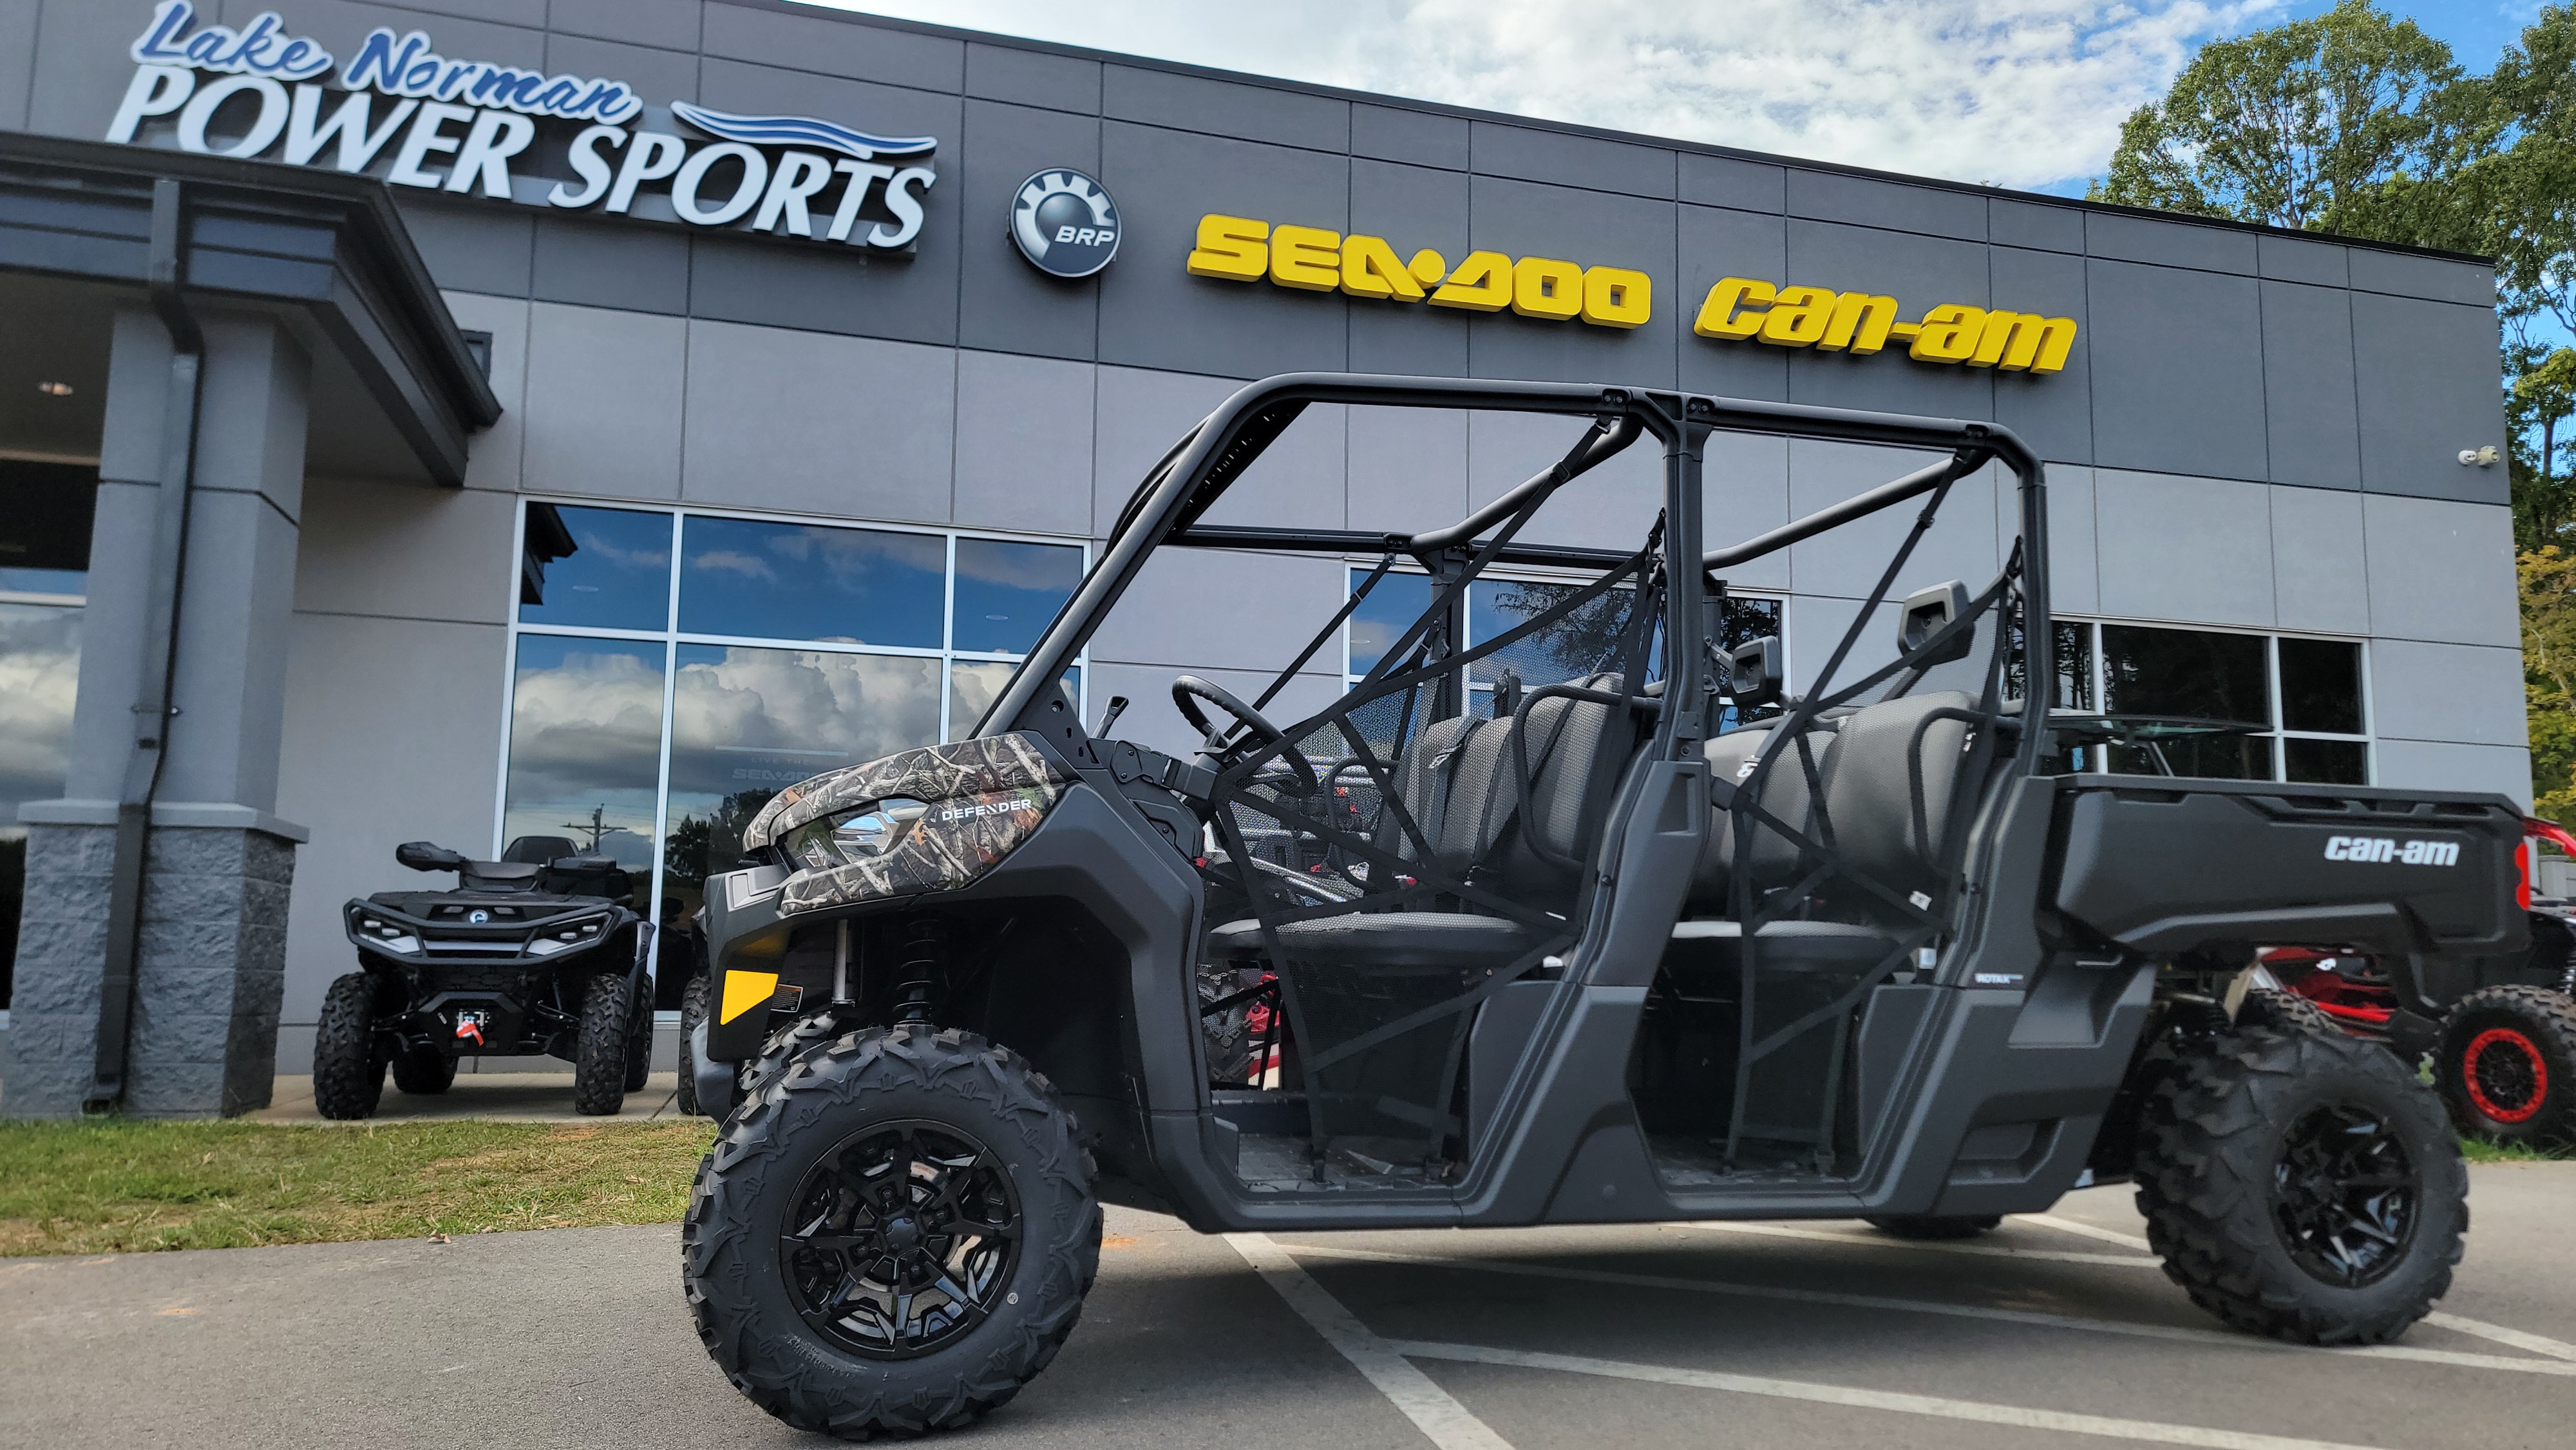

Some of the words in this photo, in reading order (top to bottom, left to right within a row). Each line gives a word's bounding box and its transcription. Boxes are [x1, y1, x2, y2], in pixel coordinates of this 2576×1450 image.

[131, 0, 334, 80] Lake
[341, 27, 643, 125] Norman
[105, 64, 535, 199] POWER
[547, 124, 937, 249] SPORTS
[1054, 225, 1115, 247] BRP
[942, 799, 1031, 821] DEFENDER
[2324, 836, 2459, 866] can-am
